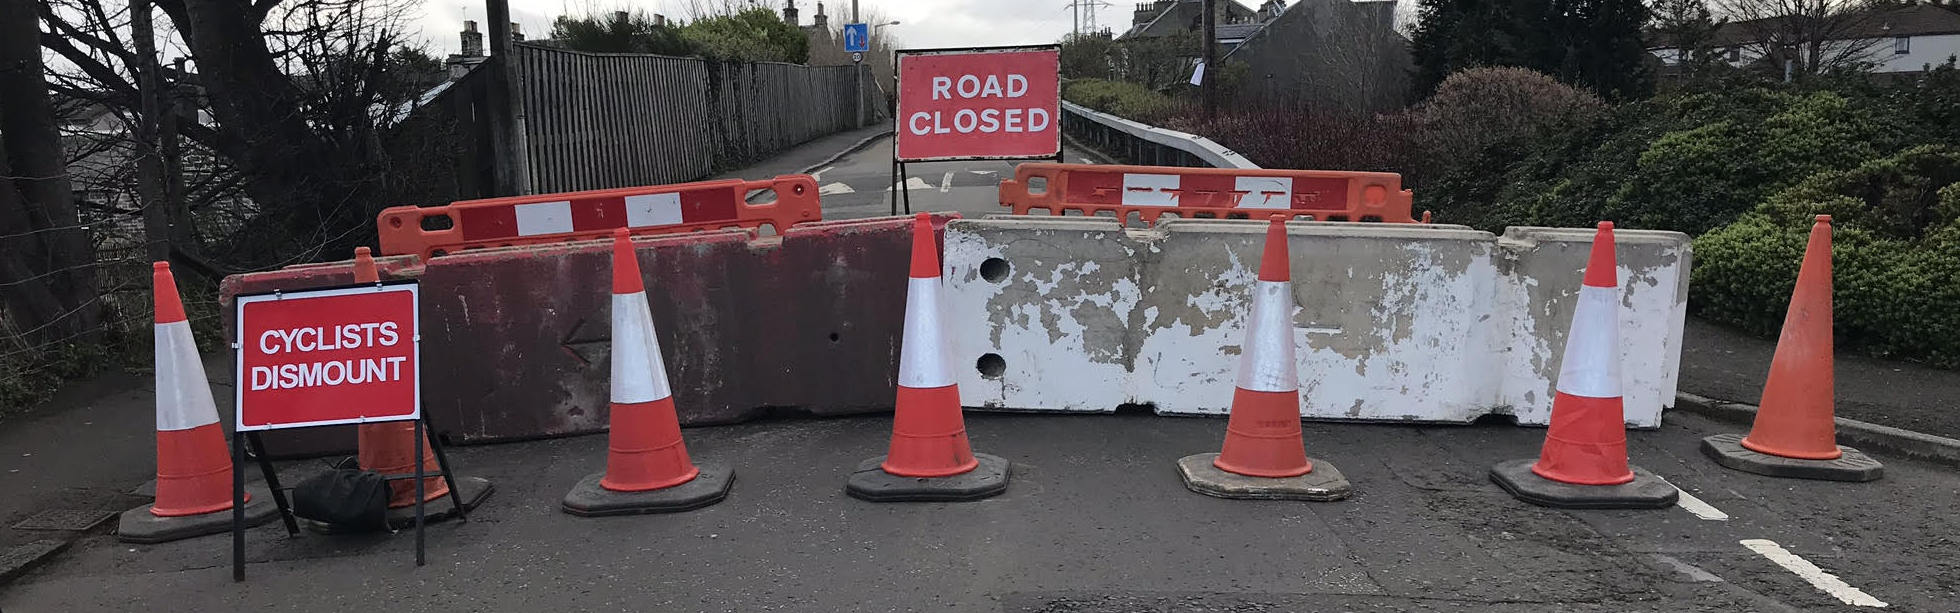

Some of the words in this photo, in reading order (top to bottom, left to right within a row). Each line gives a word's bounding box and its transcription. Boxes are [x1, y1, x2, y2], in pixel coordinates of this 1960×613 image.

[932, 74, 1028, 100] ROAD
[909, 108, 1049, 136] CLOSED
[259, 321, 399, 355] CYCLISTS
[251, 356, 407, 391] DISMOUNT
